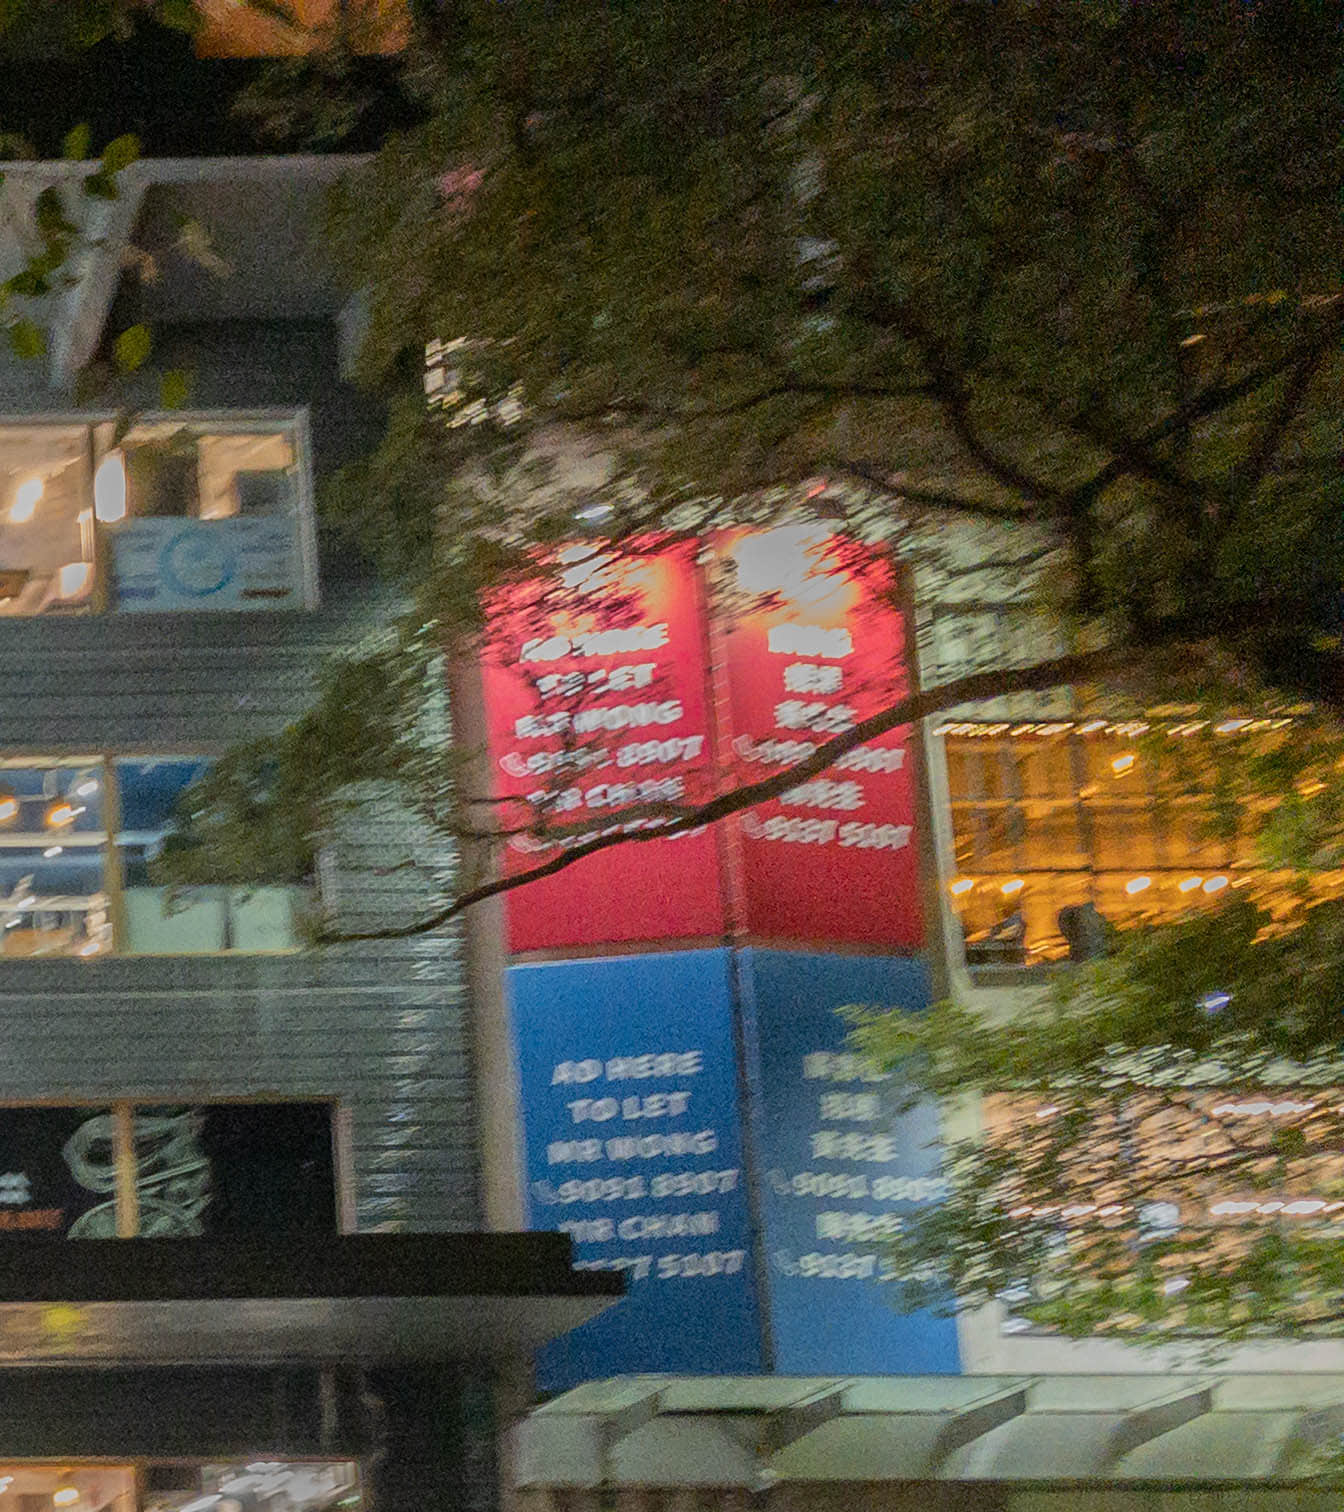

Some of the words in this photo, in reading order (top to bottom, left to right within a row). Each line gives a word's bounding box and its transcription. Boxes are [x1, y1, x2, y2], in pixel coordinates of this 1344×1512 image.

[551, 1058, 603, 1086] AD
[606, 1050, 704, 1082] HERE
[567, 1097, 621, 1124] TO
[623, 1090, 693, 1120] LET
[547, 1138, 603, 1165] MR
[606, 1130, 717, 1161] WONG
[618, 1211, 720, 1240] CHAN
